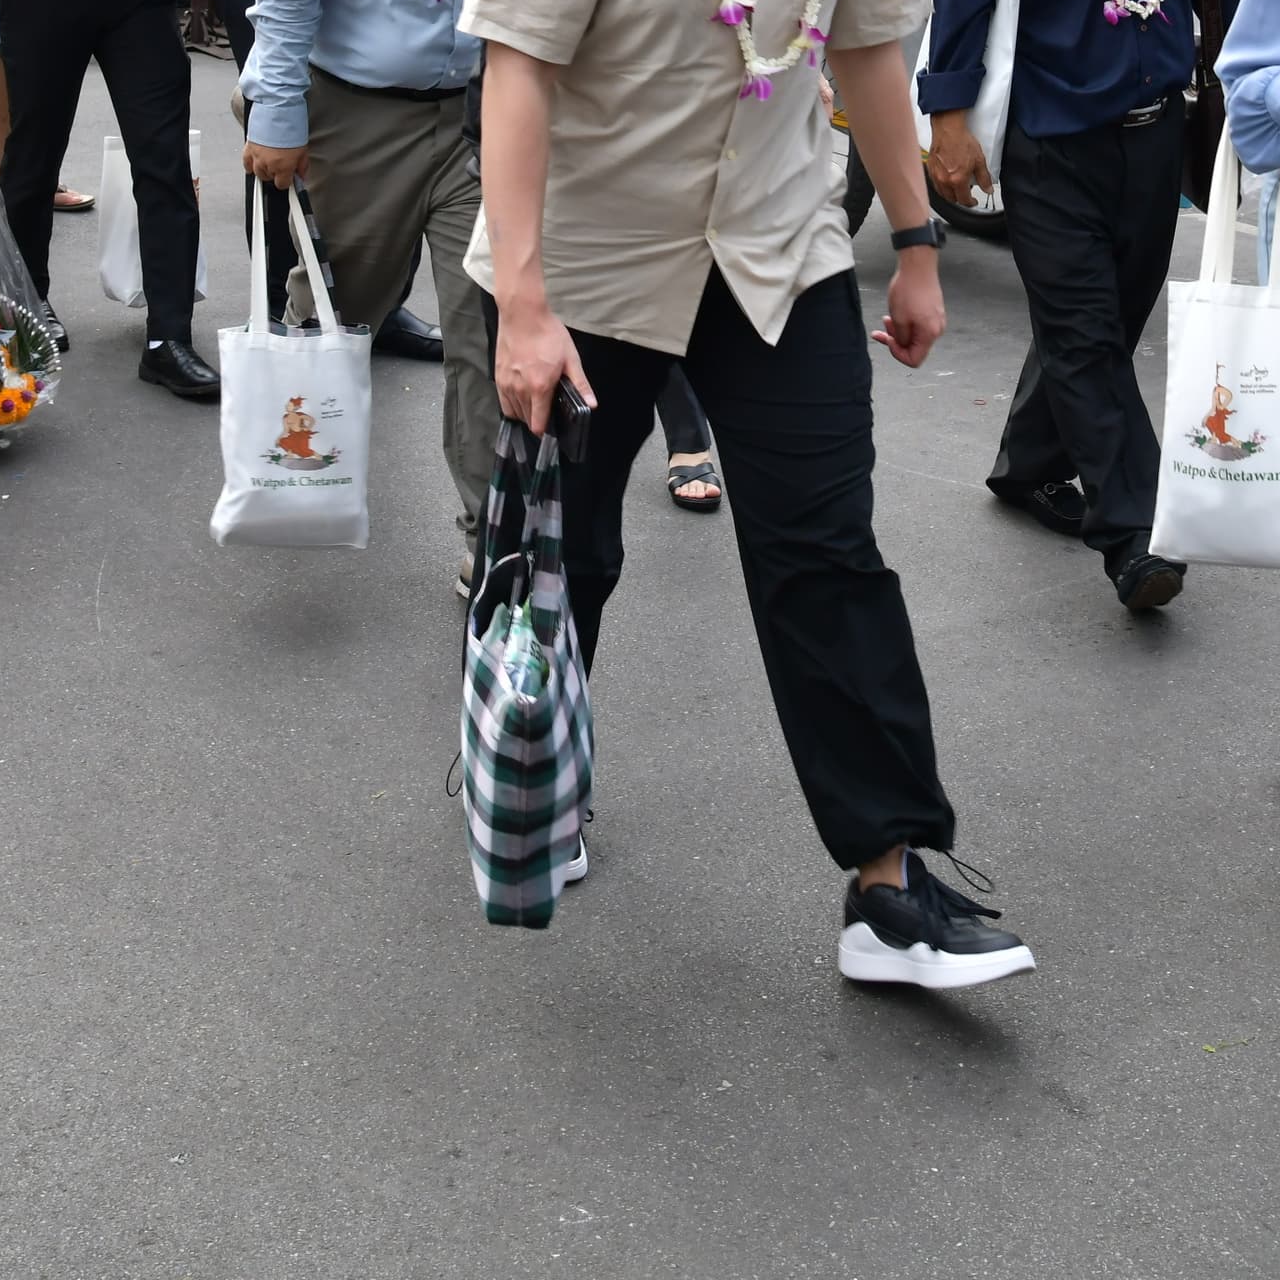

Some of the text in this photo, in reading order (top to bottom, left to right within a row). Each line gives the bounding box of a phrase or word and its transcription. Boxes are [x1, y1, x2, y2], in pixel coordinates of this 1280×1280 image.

[1173, 460, 1207, 480] Watpo
[250, 477, 287, 490] Watpo
[299, 476, 353, 487] Chetawan
